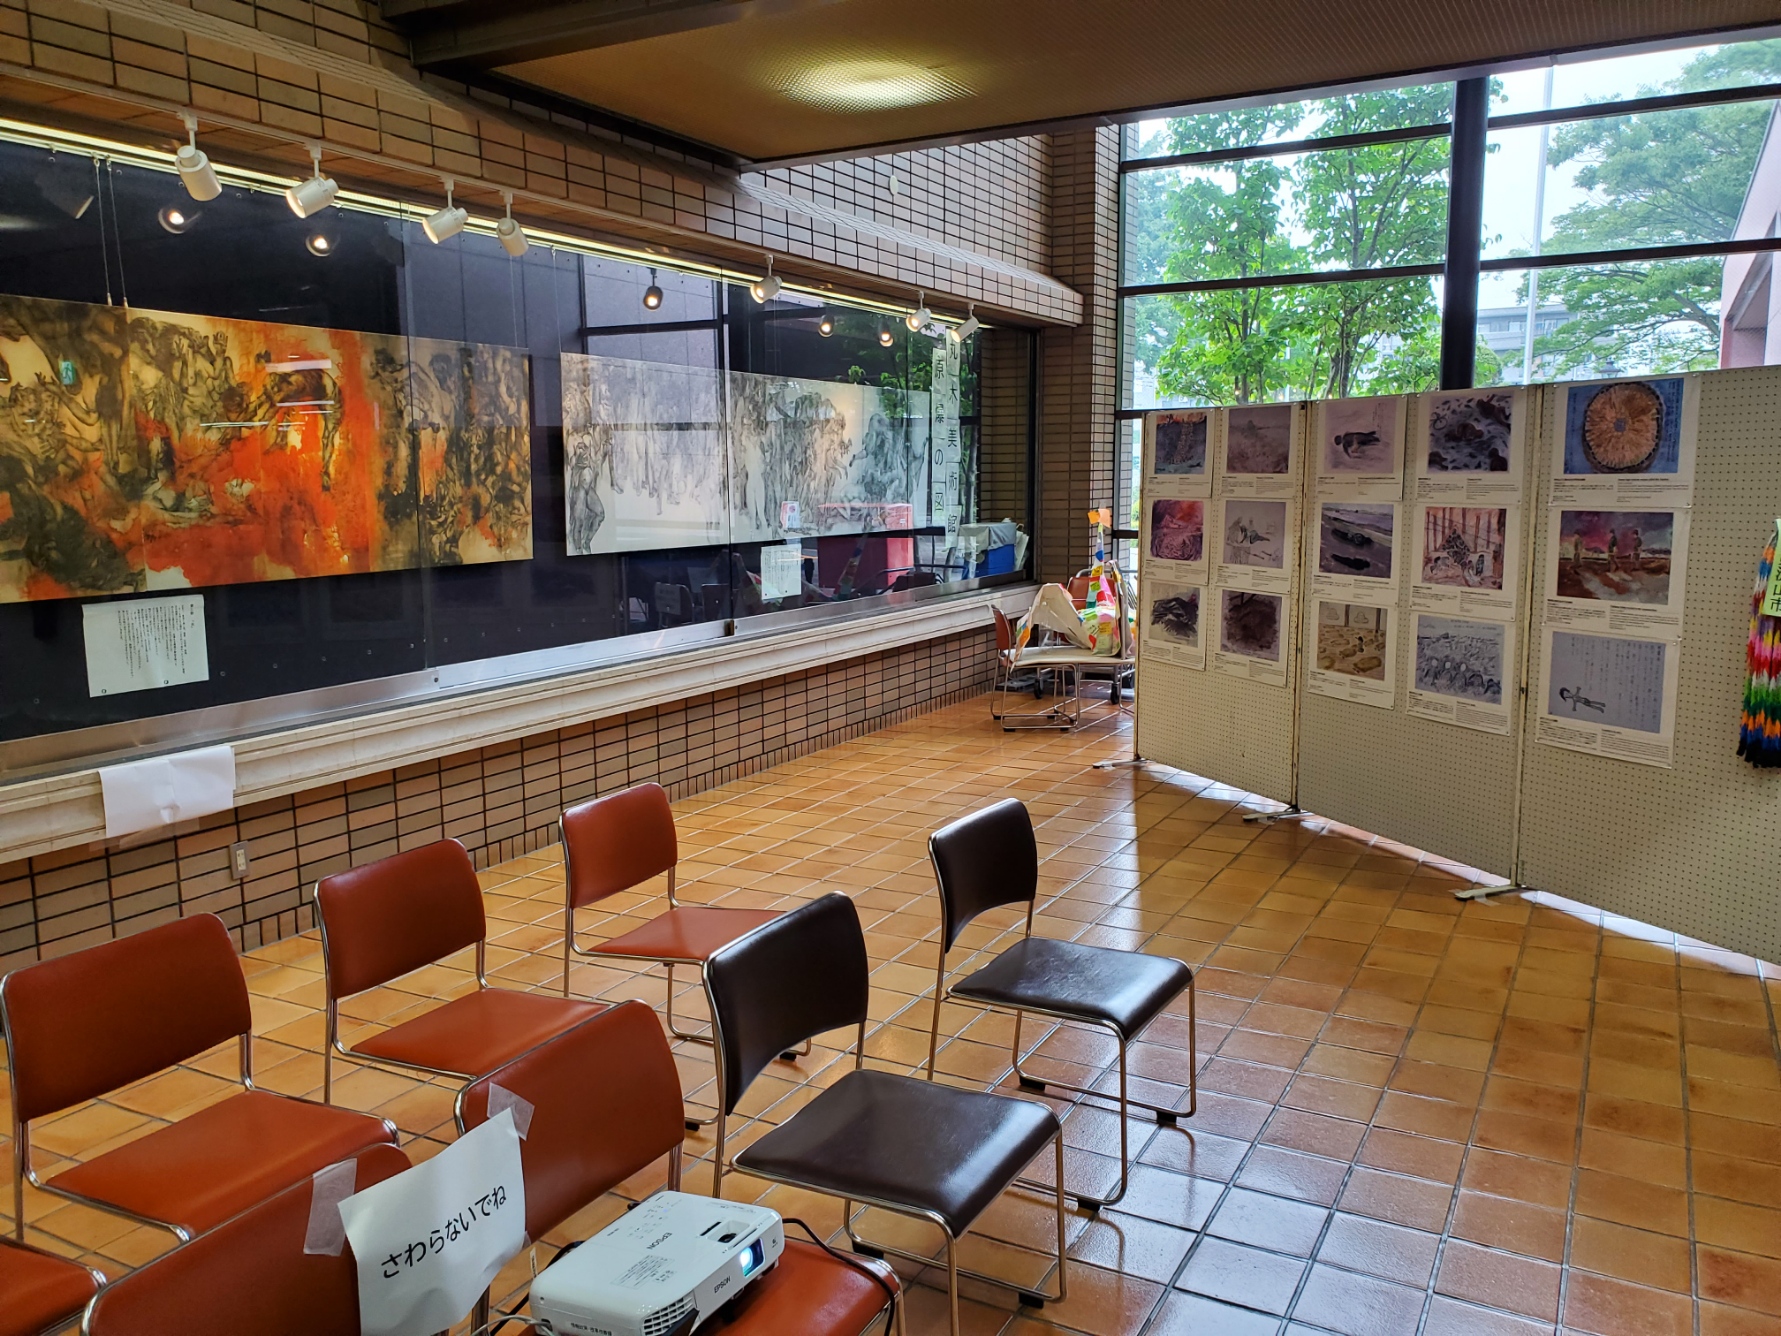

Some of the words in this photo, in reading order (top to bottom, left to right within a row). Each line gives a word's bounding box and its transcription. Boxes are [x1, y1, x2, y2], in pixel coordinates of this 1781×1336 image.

[381, 1185, 507, 1279] さわらないでね
[646, 1231, 673, 1250] EPSON
[713, 1275, 731, 1294] EPSON
